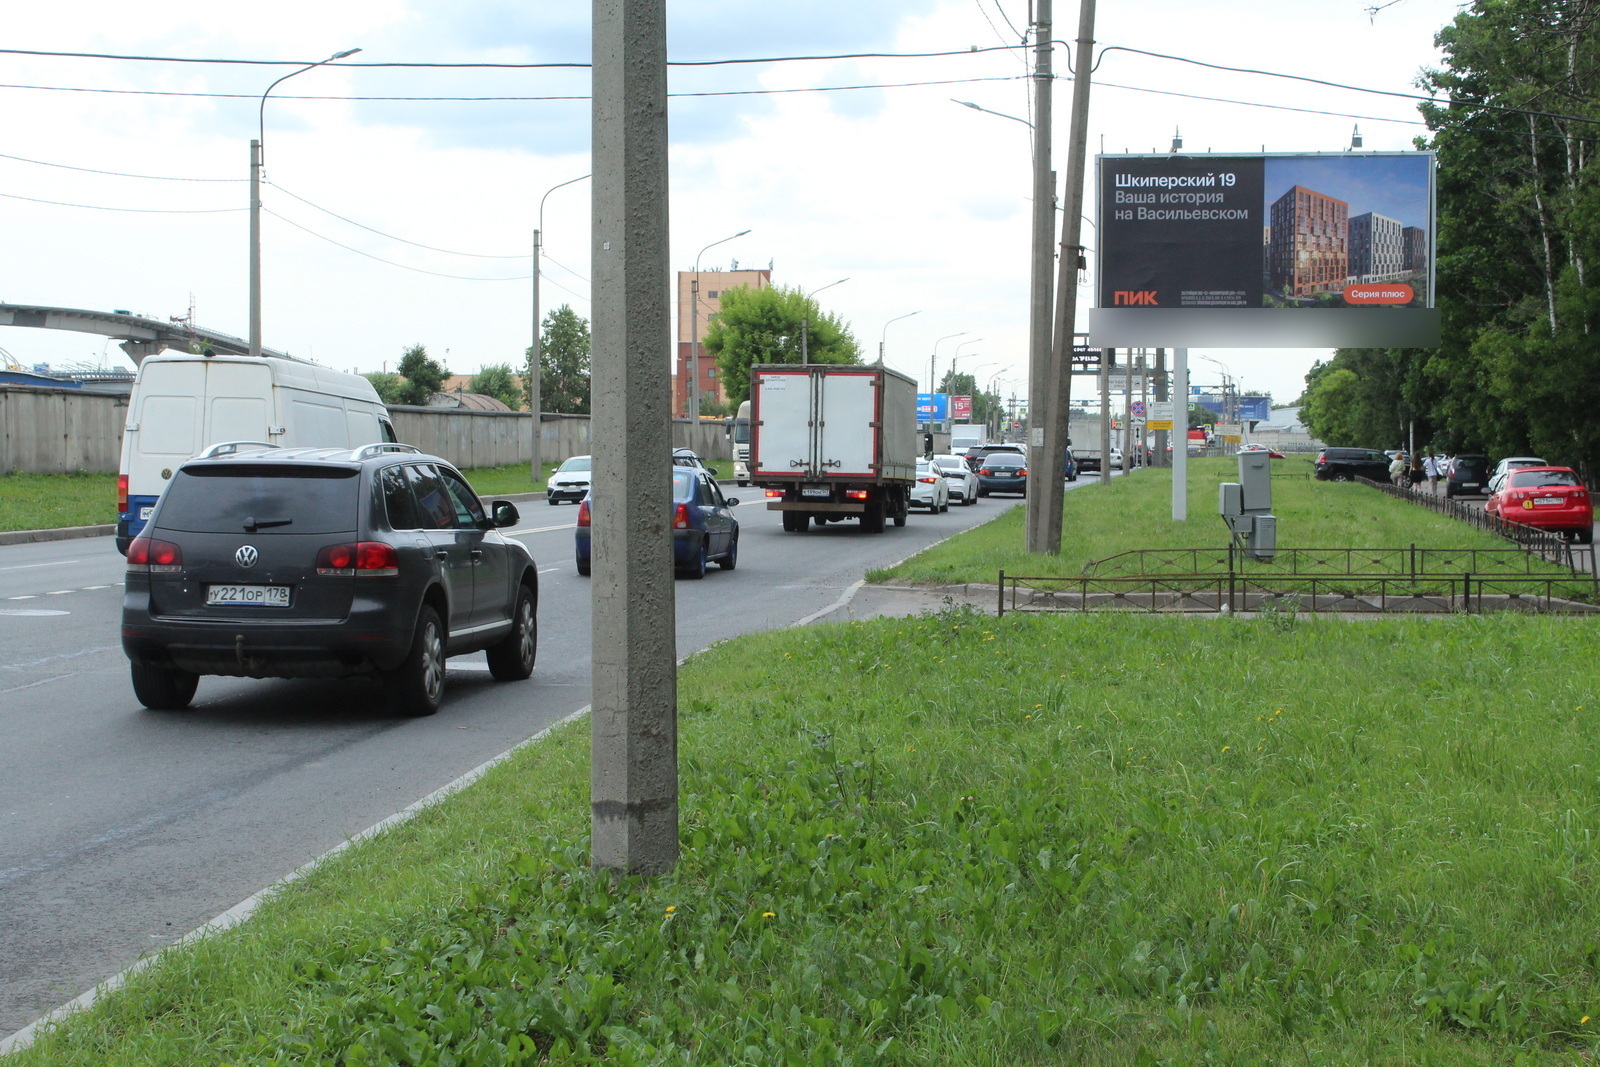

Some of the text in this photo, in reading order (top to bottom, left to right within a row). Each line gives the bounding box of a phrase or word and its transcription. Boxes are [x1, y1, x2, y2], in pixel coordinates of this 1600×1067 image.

[1115, 173, 1236, 190] Шкиперский 19
[1115, 191, 1224, 206] Ваша история
[1115, 207, 1248, 220] на Васильевском
[1114, 291, 1159, 305] ПИК
[1351, 290, 1380, 299] Серия
[954, 402, 964, 410] 15
[213, 587, 263, 601] У221ОР
